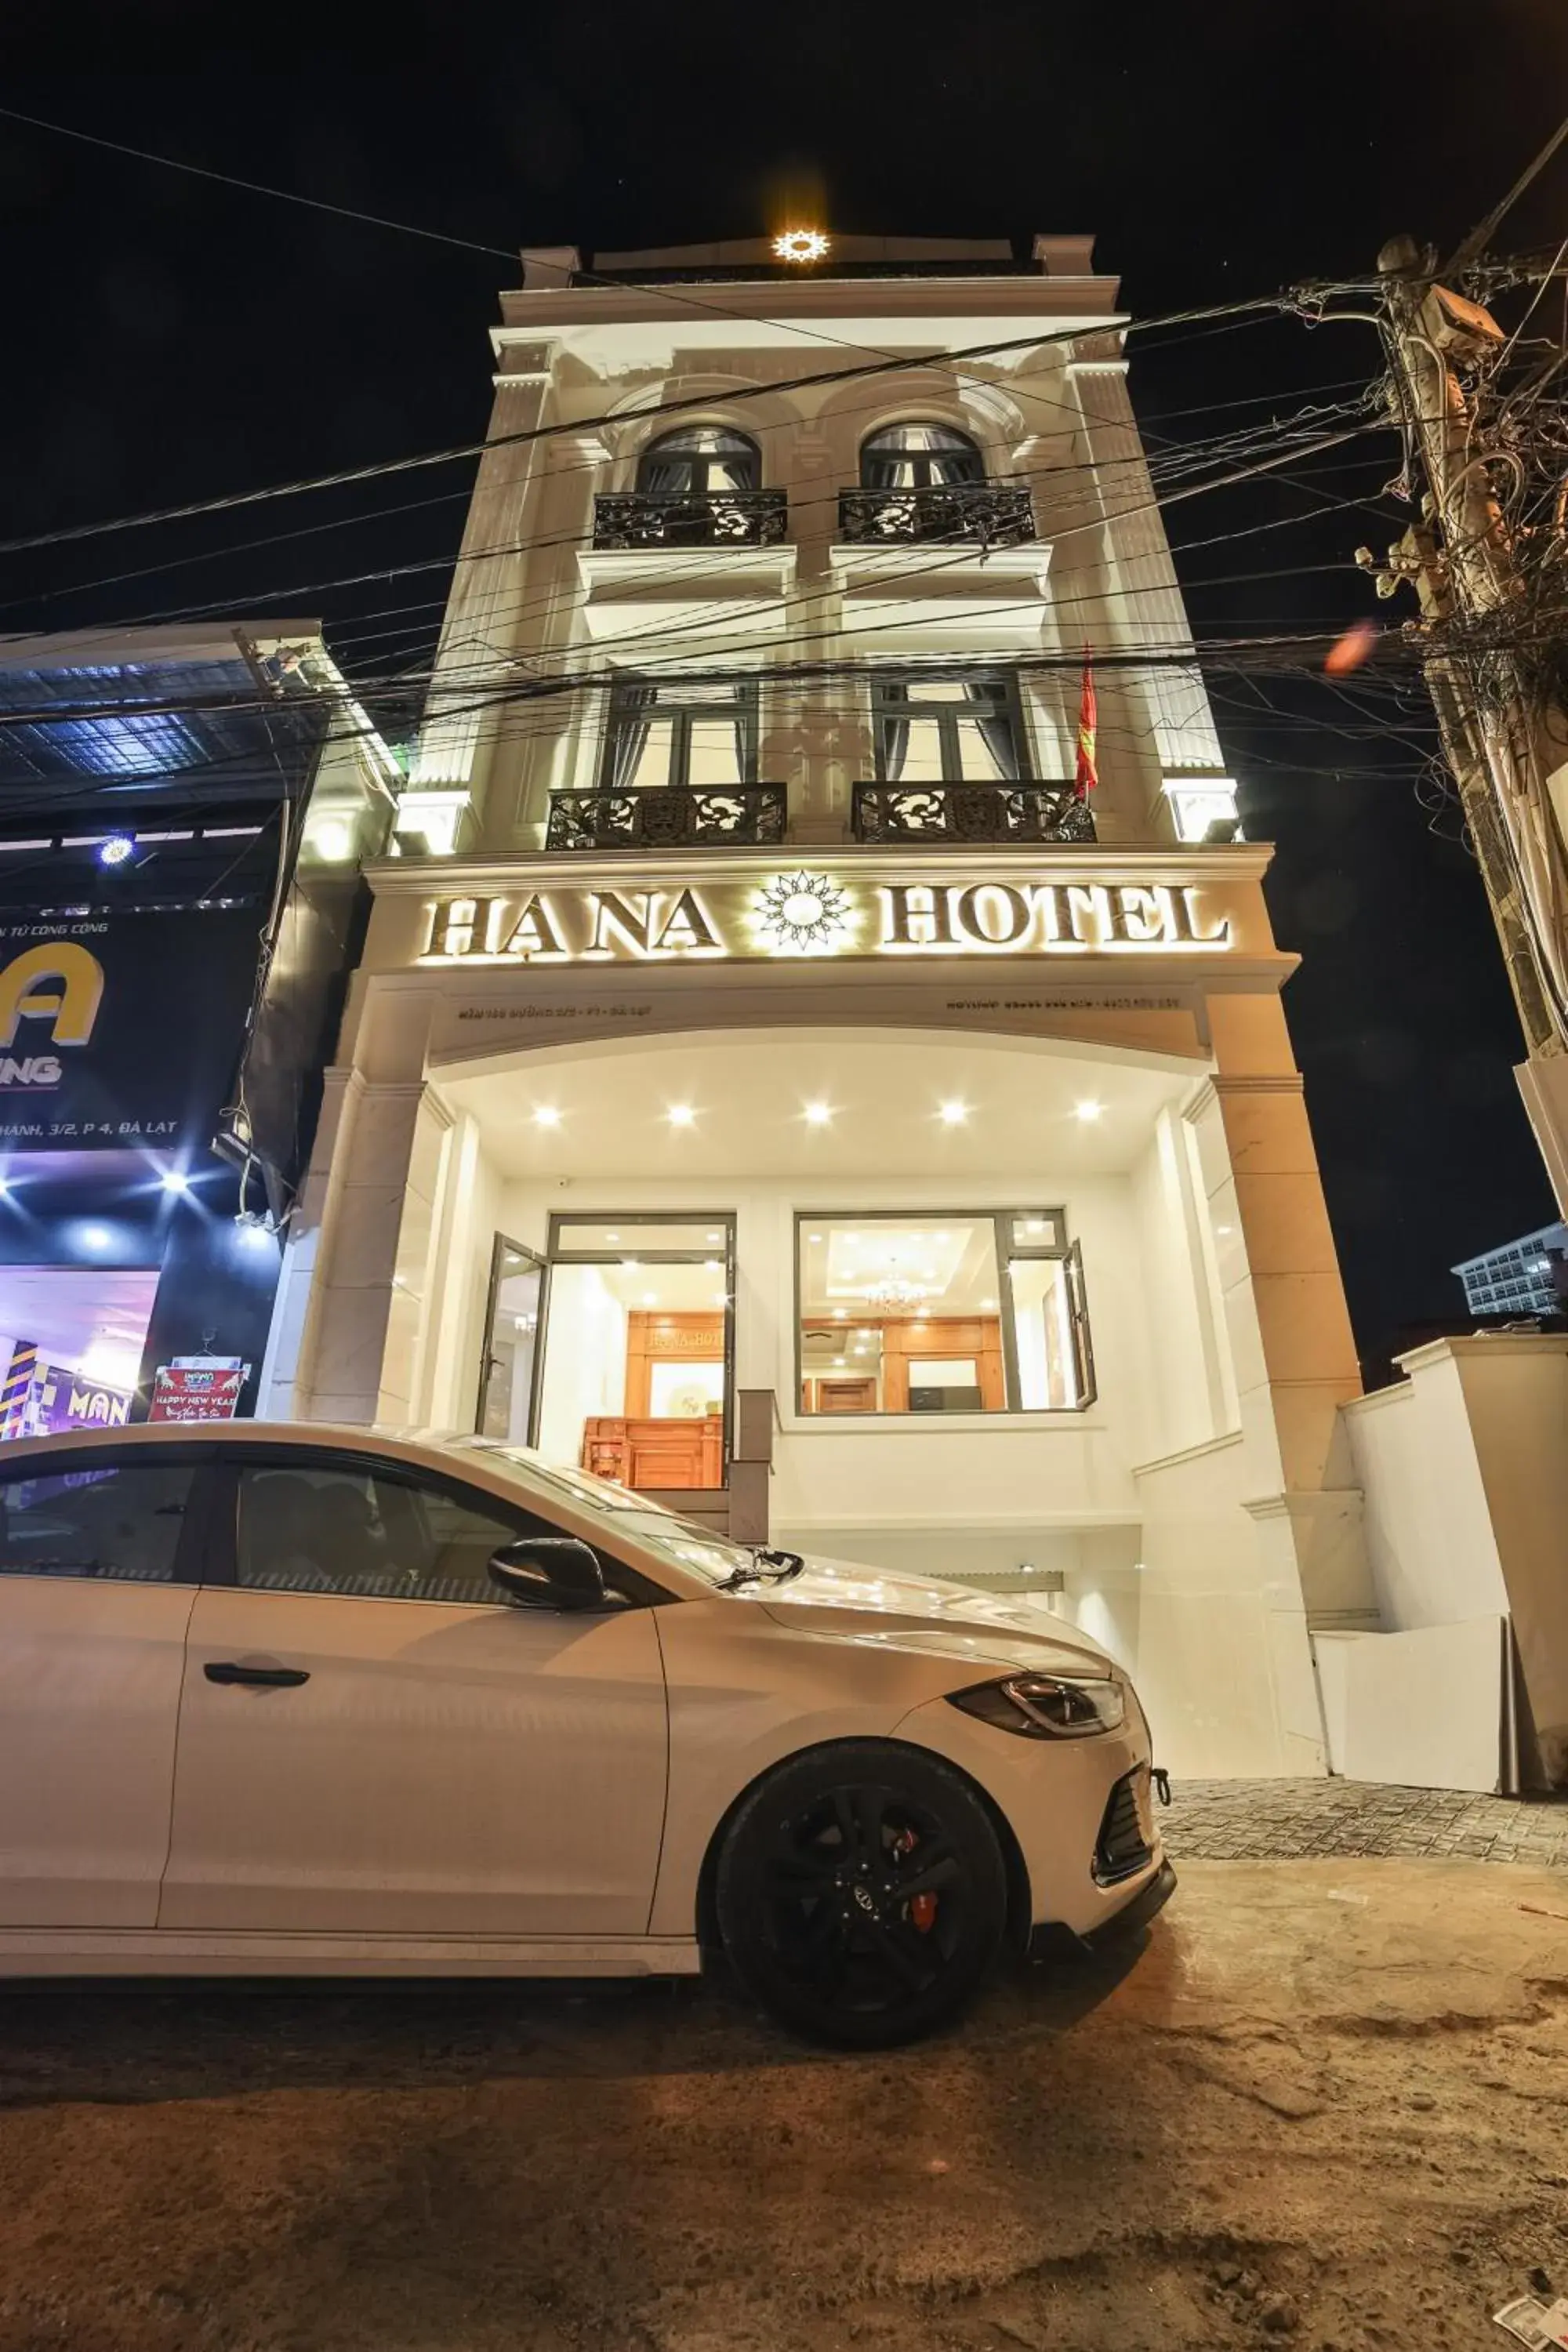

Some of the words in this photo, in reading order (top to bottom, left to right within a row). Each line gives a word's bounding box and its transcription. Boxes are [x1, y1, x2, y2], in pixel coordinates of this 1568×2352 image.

[881, 882, 1229, 944] HOTEL
[157, 1396, 187, 1405] HAPPY
[188, 1396, 209, 1406] NEW
